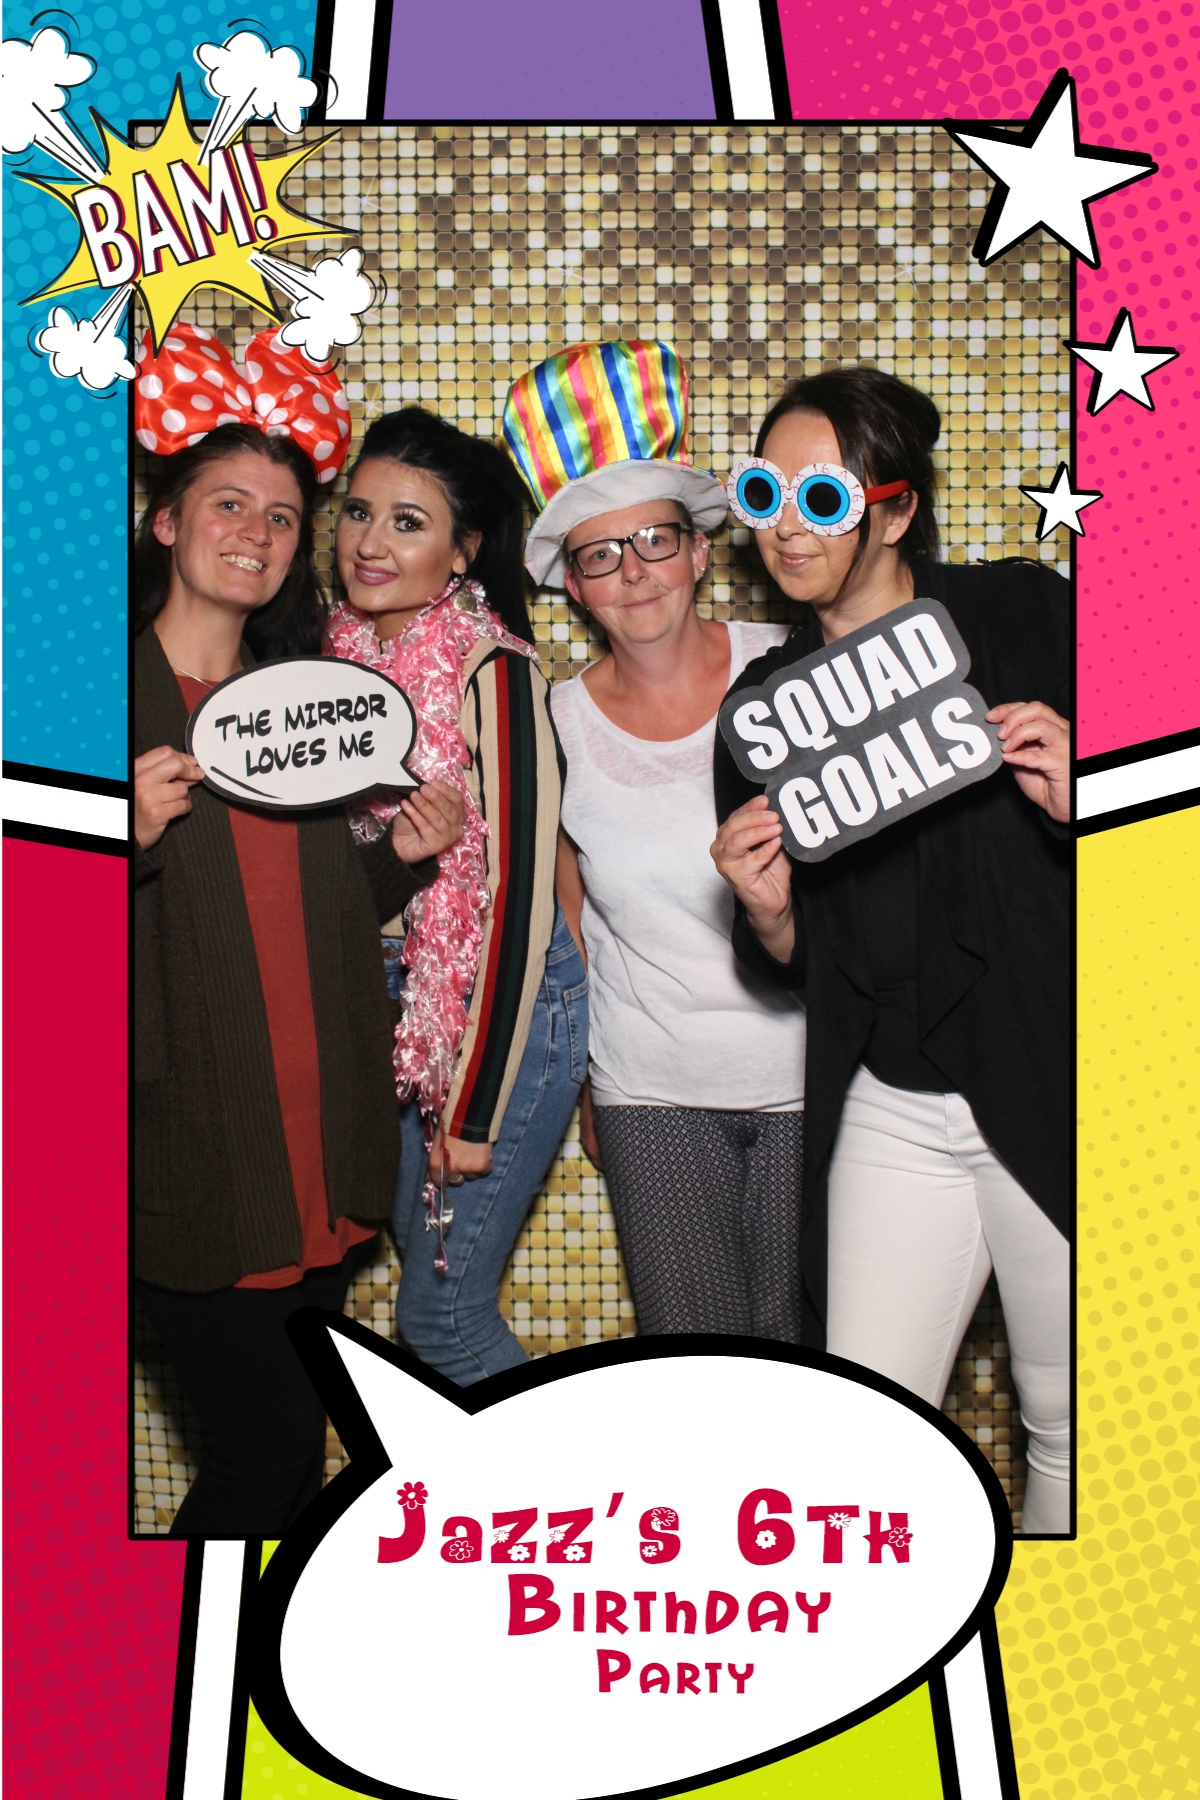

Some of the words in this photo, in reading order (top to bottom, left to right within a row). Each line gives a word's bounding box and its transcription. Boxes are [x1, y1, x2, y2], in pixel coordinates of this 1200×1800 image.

[214, 709, 272, 742] THE
[284, 694, 388, 733] MIRROR
[733, 613, 957, 770] SQUAD
[245, 738, 327, 777] LOVES
[339, 730, 375, 762] ME
[778, 697, 992, 849] GOALS
